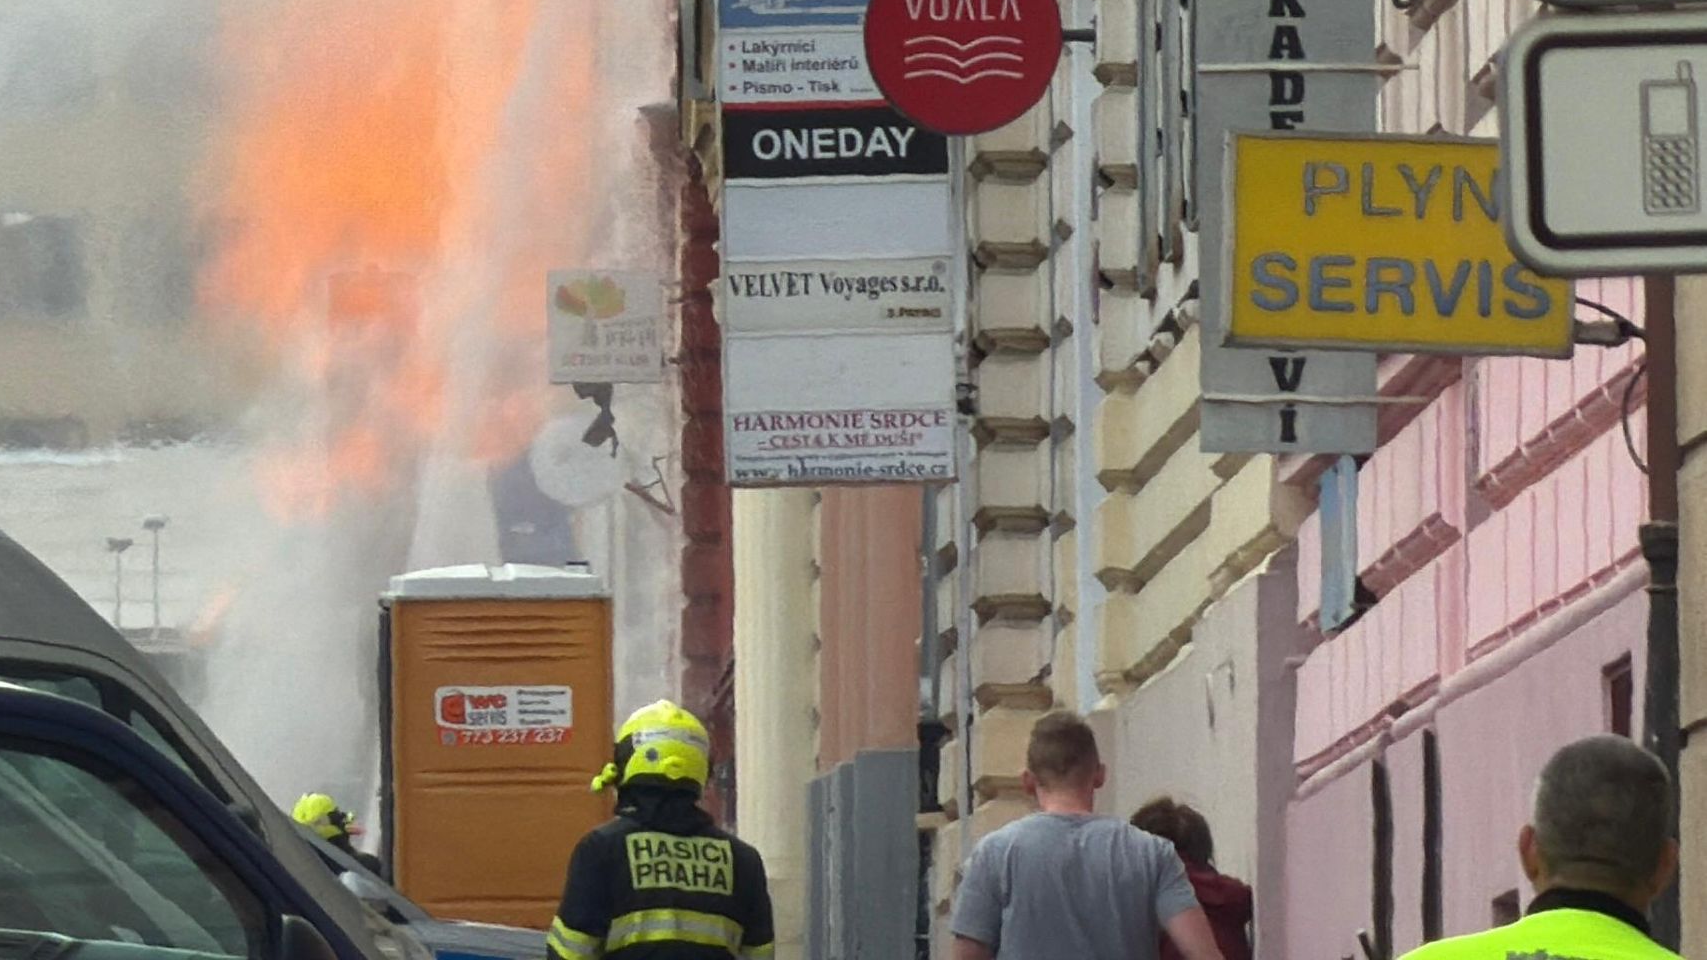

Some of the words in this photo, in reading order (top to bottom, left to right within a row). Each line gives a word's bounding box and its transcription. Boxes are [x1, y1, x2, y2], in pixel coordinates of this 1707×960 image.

[807, 79, 841, 93] Tisk
[752, 126, 916, 160] ONEDAY
[1302, 161, 1501, 223] PLYN
[728, 271, 812, 297] VELVET
[819, 272, 898, 301] Voyages
[901, 275, 946, 293] s.r.o.
[1249, 252, 1551, 320] SERVIS
[734, 411, 864, 432] HARMONIE
[870, 410, 947, 429] SRDCE
[636, 860, 728, 890] PRAHA
